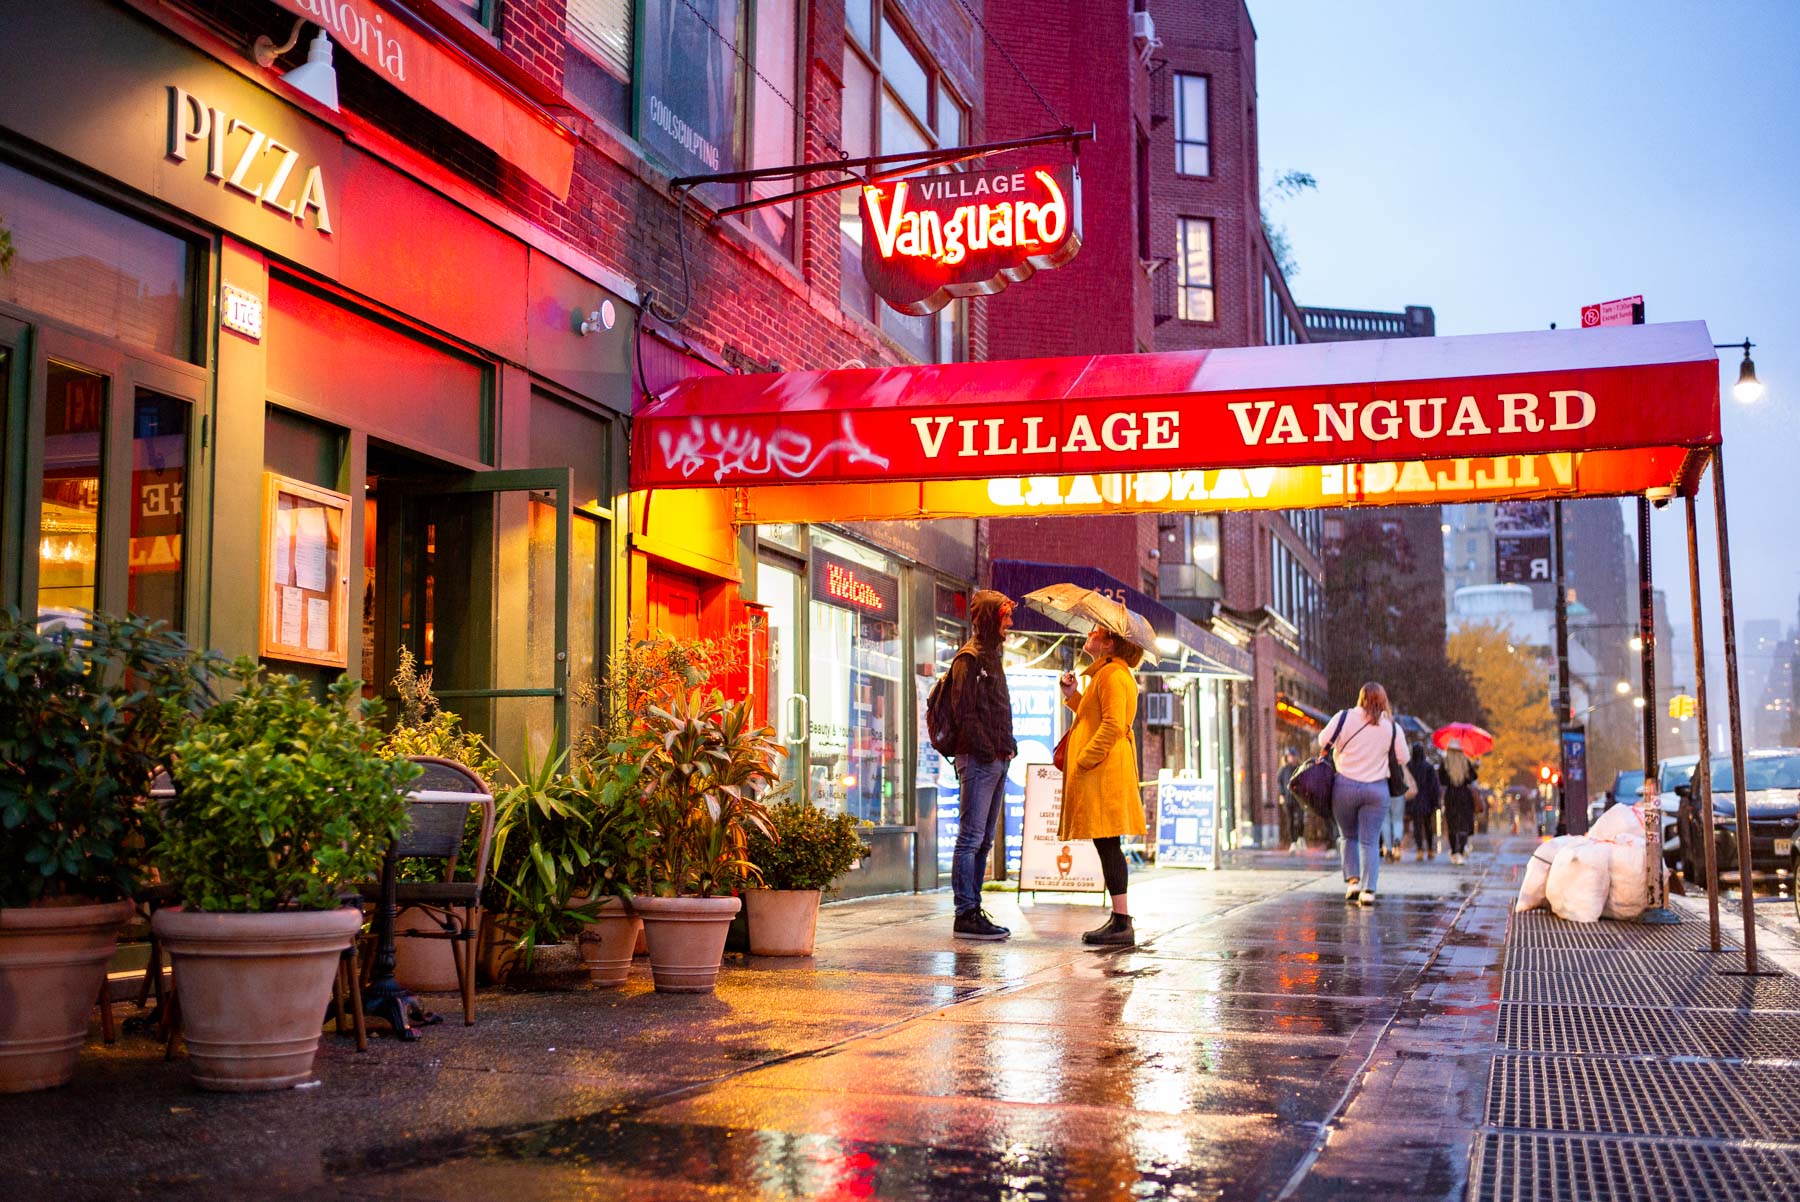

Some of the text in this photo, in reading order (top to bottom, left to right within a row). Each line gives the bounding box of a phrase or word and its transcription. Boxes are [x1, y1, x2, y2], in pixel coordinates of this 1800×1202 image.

[165, 86, 333, 233] PIZZA
[650, 96, 719, 171] COOLSCULPTING
[863, 171, 1067, 265] Vanguard
[921, 174, 1026, 200] VILLAGE
[911, 411, 1180, 458] VILLAGE
[1228, 390, 1597, 445] VANGUARD
